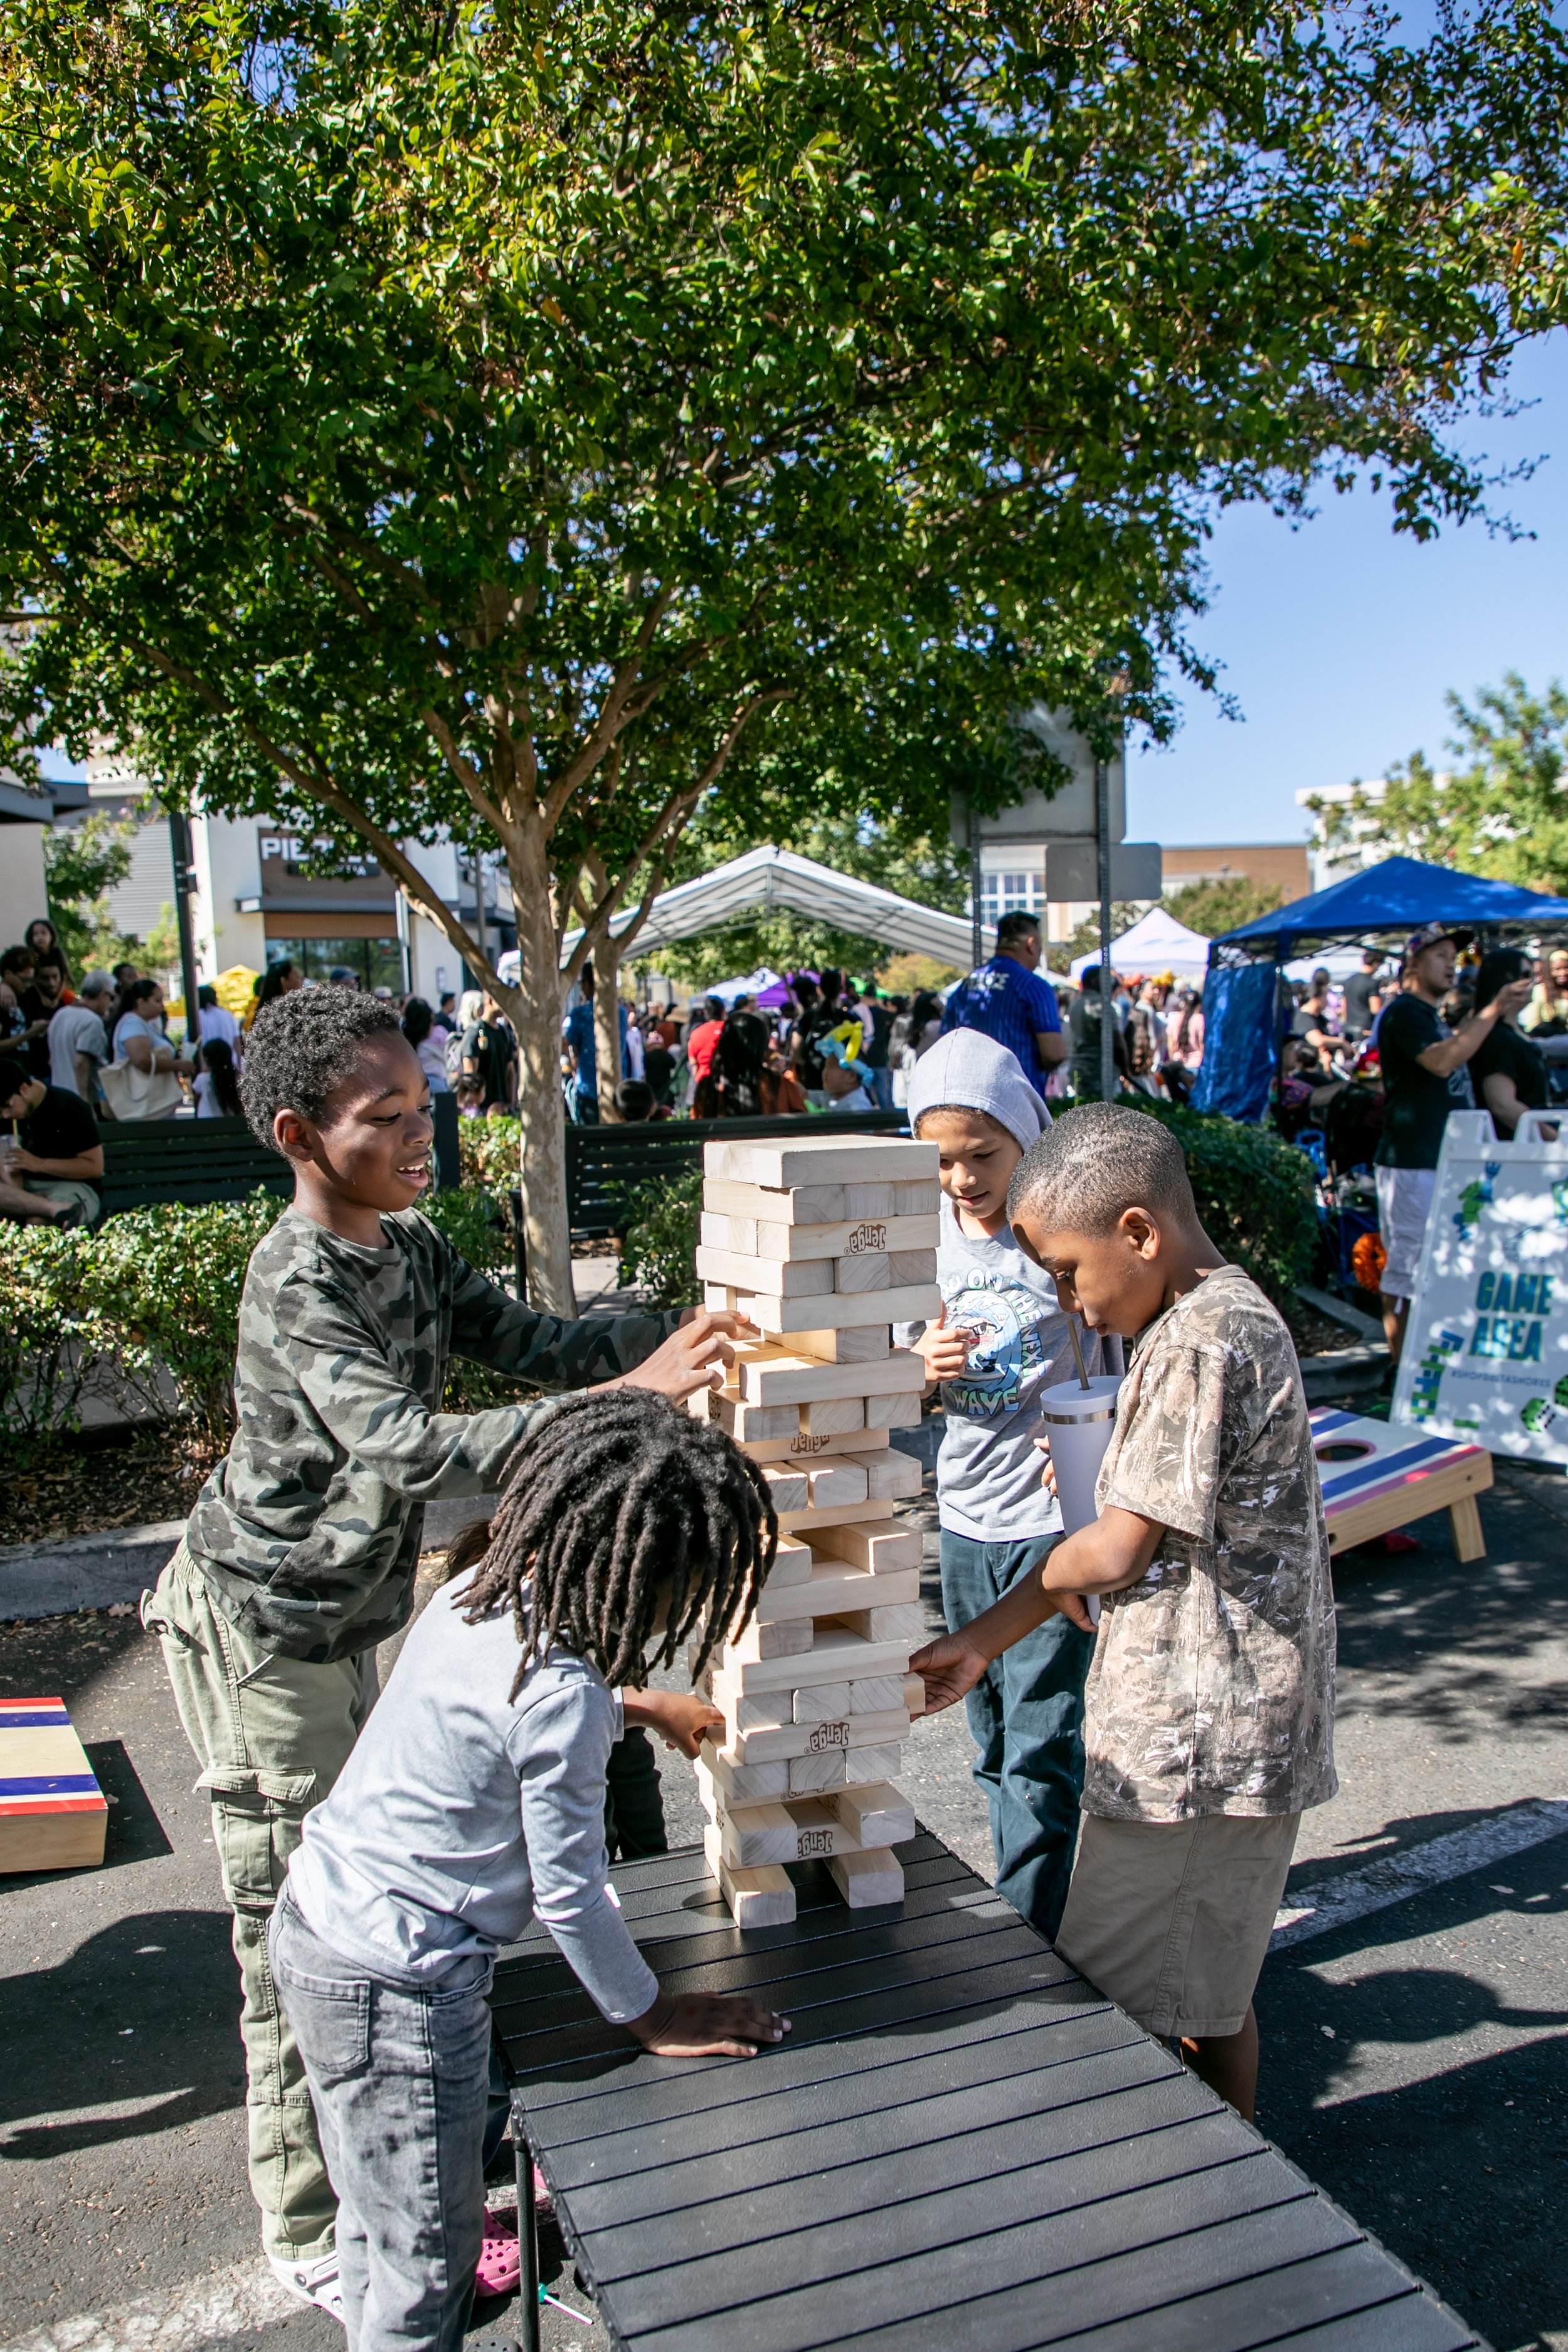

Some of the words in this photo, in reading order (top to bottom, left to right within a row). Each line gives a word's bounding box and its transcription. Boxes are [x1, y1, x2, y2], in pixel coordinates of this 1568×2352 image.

[967, 1268, 1004, 1293] ON
[1004, 1278, 1044, 1325] THE
[1475, 1271, 1557, 1316] GAME
[1020, 1322, 1048, 1378] NEXT
[1468, 1316, 1542, 1362] AREA
[948, 1386, 1020, 1416] WAVE
